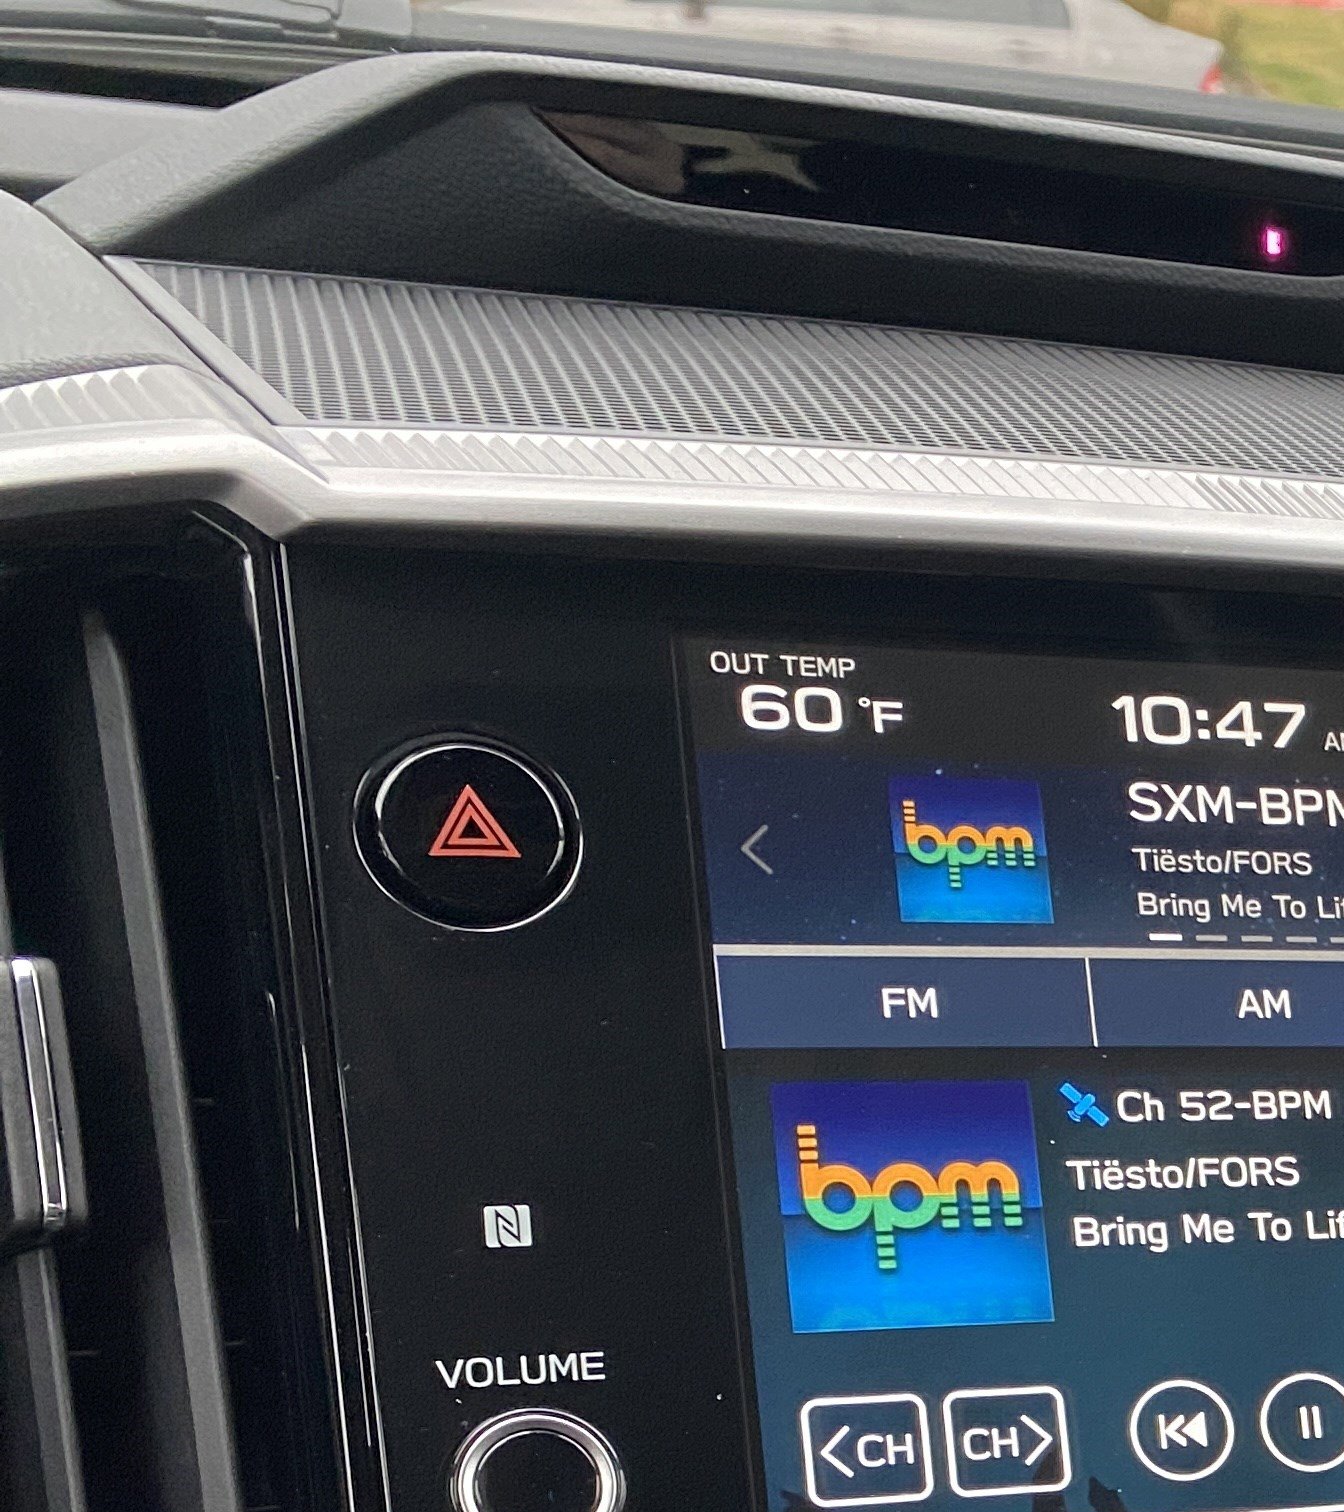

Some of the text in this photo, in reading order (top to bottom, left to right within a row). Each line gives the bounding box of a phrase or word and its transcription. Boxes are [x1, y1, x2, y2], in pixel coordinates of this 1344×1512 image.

[710, 650, 856, 679] OUT TEMP
[739, 684, 842, 734] 60
[1111, 694, 1306, 749] 10:47
[902, 799, 1036, 888] bpm
[1131, 847, 1313, 876] Tiësto/FORS
[1138, 891, 1210, 924] Bring
[1222, 896, 1261, 918] Me
[1271, 896, 1306, 919] To
[881, 986, 939, 1020] FM
[1237, 988, 1292, 1020] AM
[1115, 1089, 1333, 1123] Ch 52-BPM
[1067, 1155, 1301, 1191] Tiësto/FORS
[797, 1124, 1023, 1270] bpm
[1073, 1214, 1169, 1251] Bring
[1182, 1213, 1236, 1244] Me
[1248, 1212, 1293, 1243] To
[435, 1351, 606, 1389] VOLUME
[857, 1432, 915, 1469] CH
[962, 1426, 1019, 1461] CH
